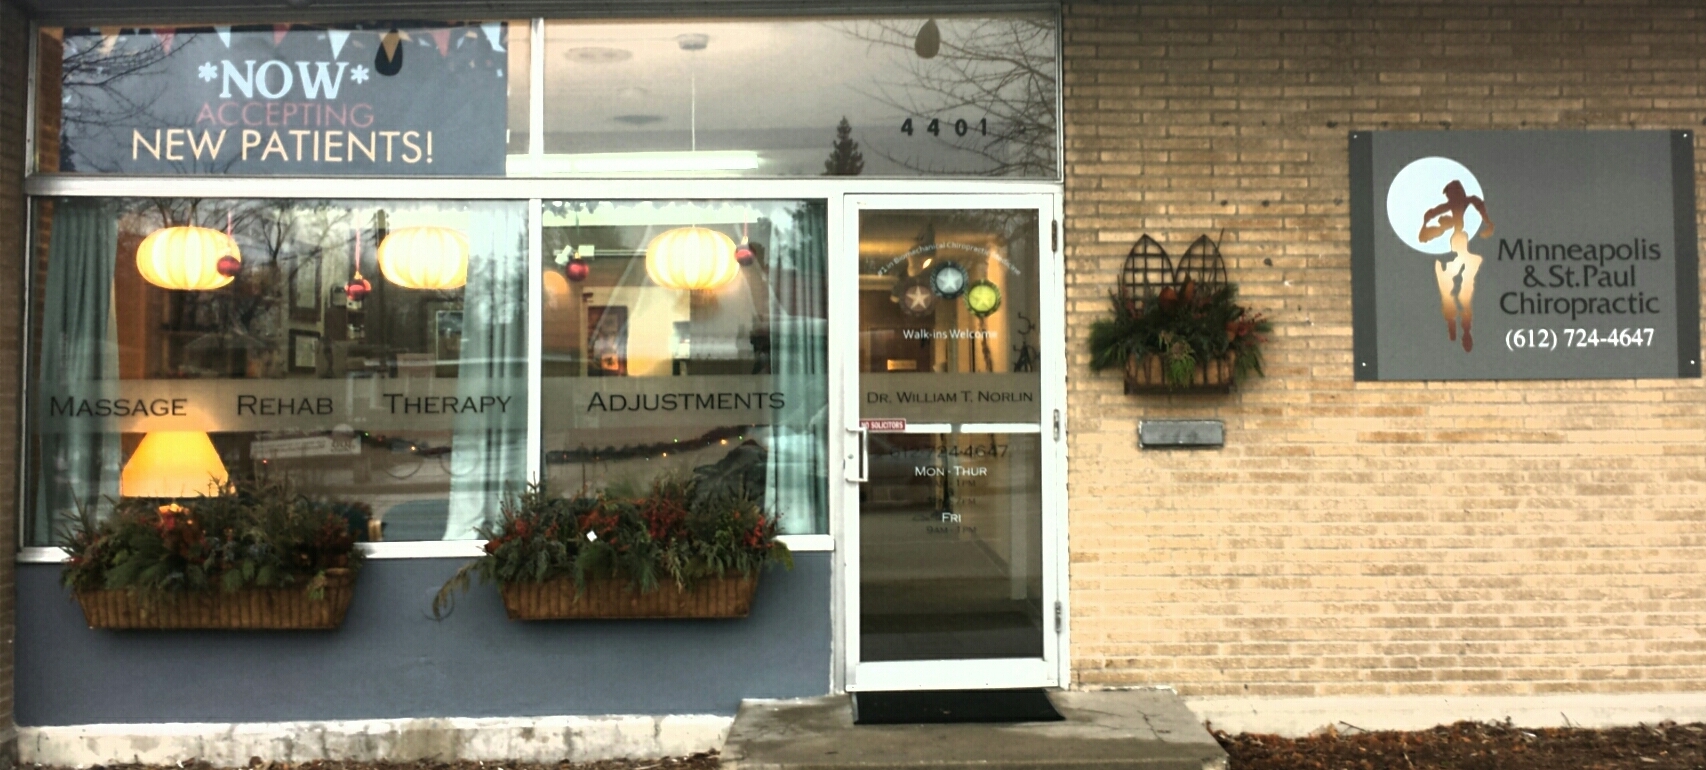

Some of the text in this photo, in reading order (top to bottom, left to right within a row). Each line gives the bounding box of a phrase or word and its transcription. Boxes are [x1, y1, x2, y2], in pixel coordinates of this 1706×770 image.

[195, 101, 374, 128] ACCEPTING
[900, 117, 987, 137] 4401
[131, 128, 434, 164] NEW PATIENTS!
[1497, 238, 1662, 267] Minneapolis
[1499, 291, 1661, 321] Chiropractic
[902, 329, 998, 340] Walk-ins Welcome
[1505, 328, 1655, 352] (612) 724-4647
[50, 393, 512, 417] MASSAGE REHAB THERAPY
[587, 391, 785, 412] ADJUSTMENTS
[866, 390, 1033, 404] DR. WILLIAM T. NORLIN
[870, 420, 904, 430] SOLICITORS
[914, 465, 945, 477] MON
[953, 465, 988, 477] THUR
[941, 512, 962, 523] FRI
